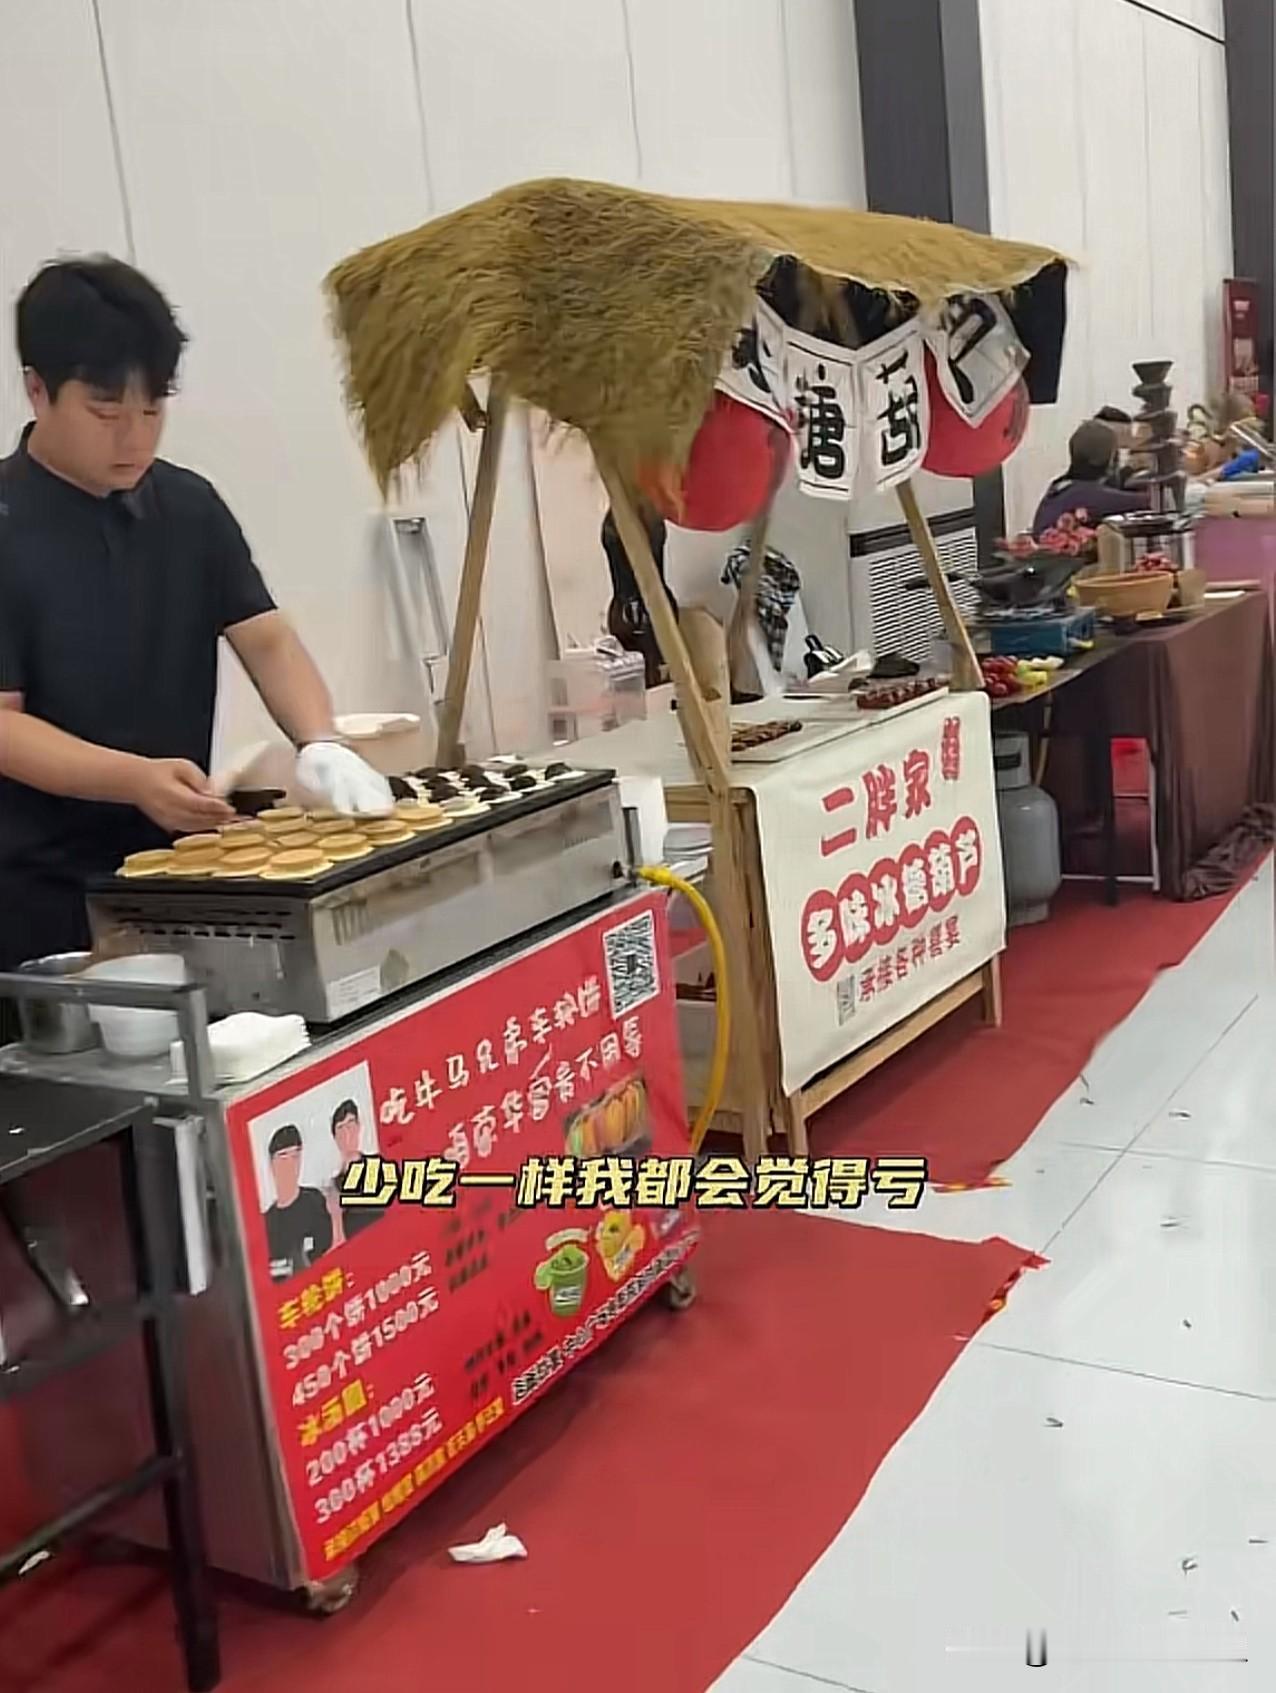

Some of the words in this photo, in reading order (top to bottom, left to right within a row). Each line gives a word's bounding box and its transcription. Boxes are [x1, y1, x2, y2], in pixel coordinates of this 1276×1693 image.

[821, 749, 931, 858] 二胖家
[806, 826, 979, 970] 多味冰糖葫芦
[380, 975, 601, 1125] 吃牛马兄弟车轮饼
[283, 1250, 433, 1370] 300个饼1000元
[292, 1286, 440, 1408] 450个饼1500元
[306, 1372, 436, 1486] 200杯1000元
